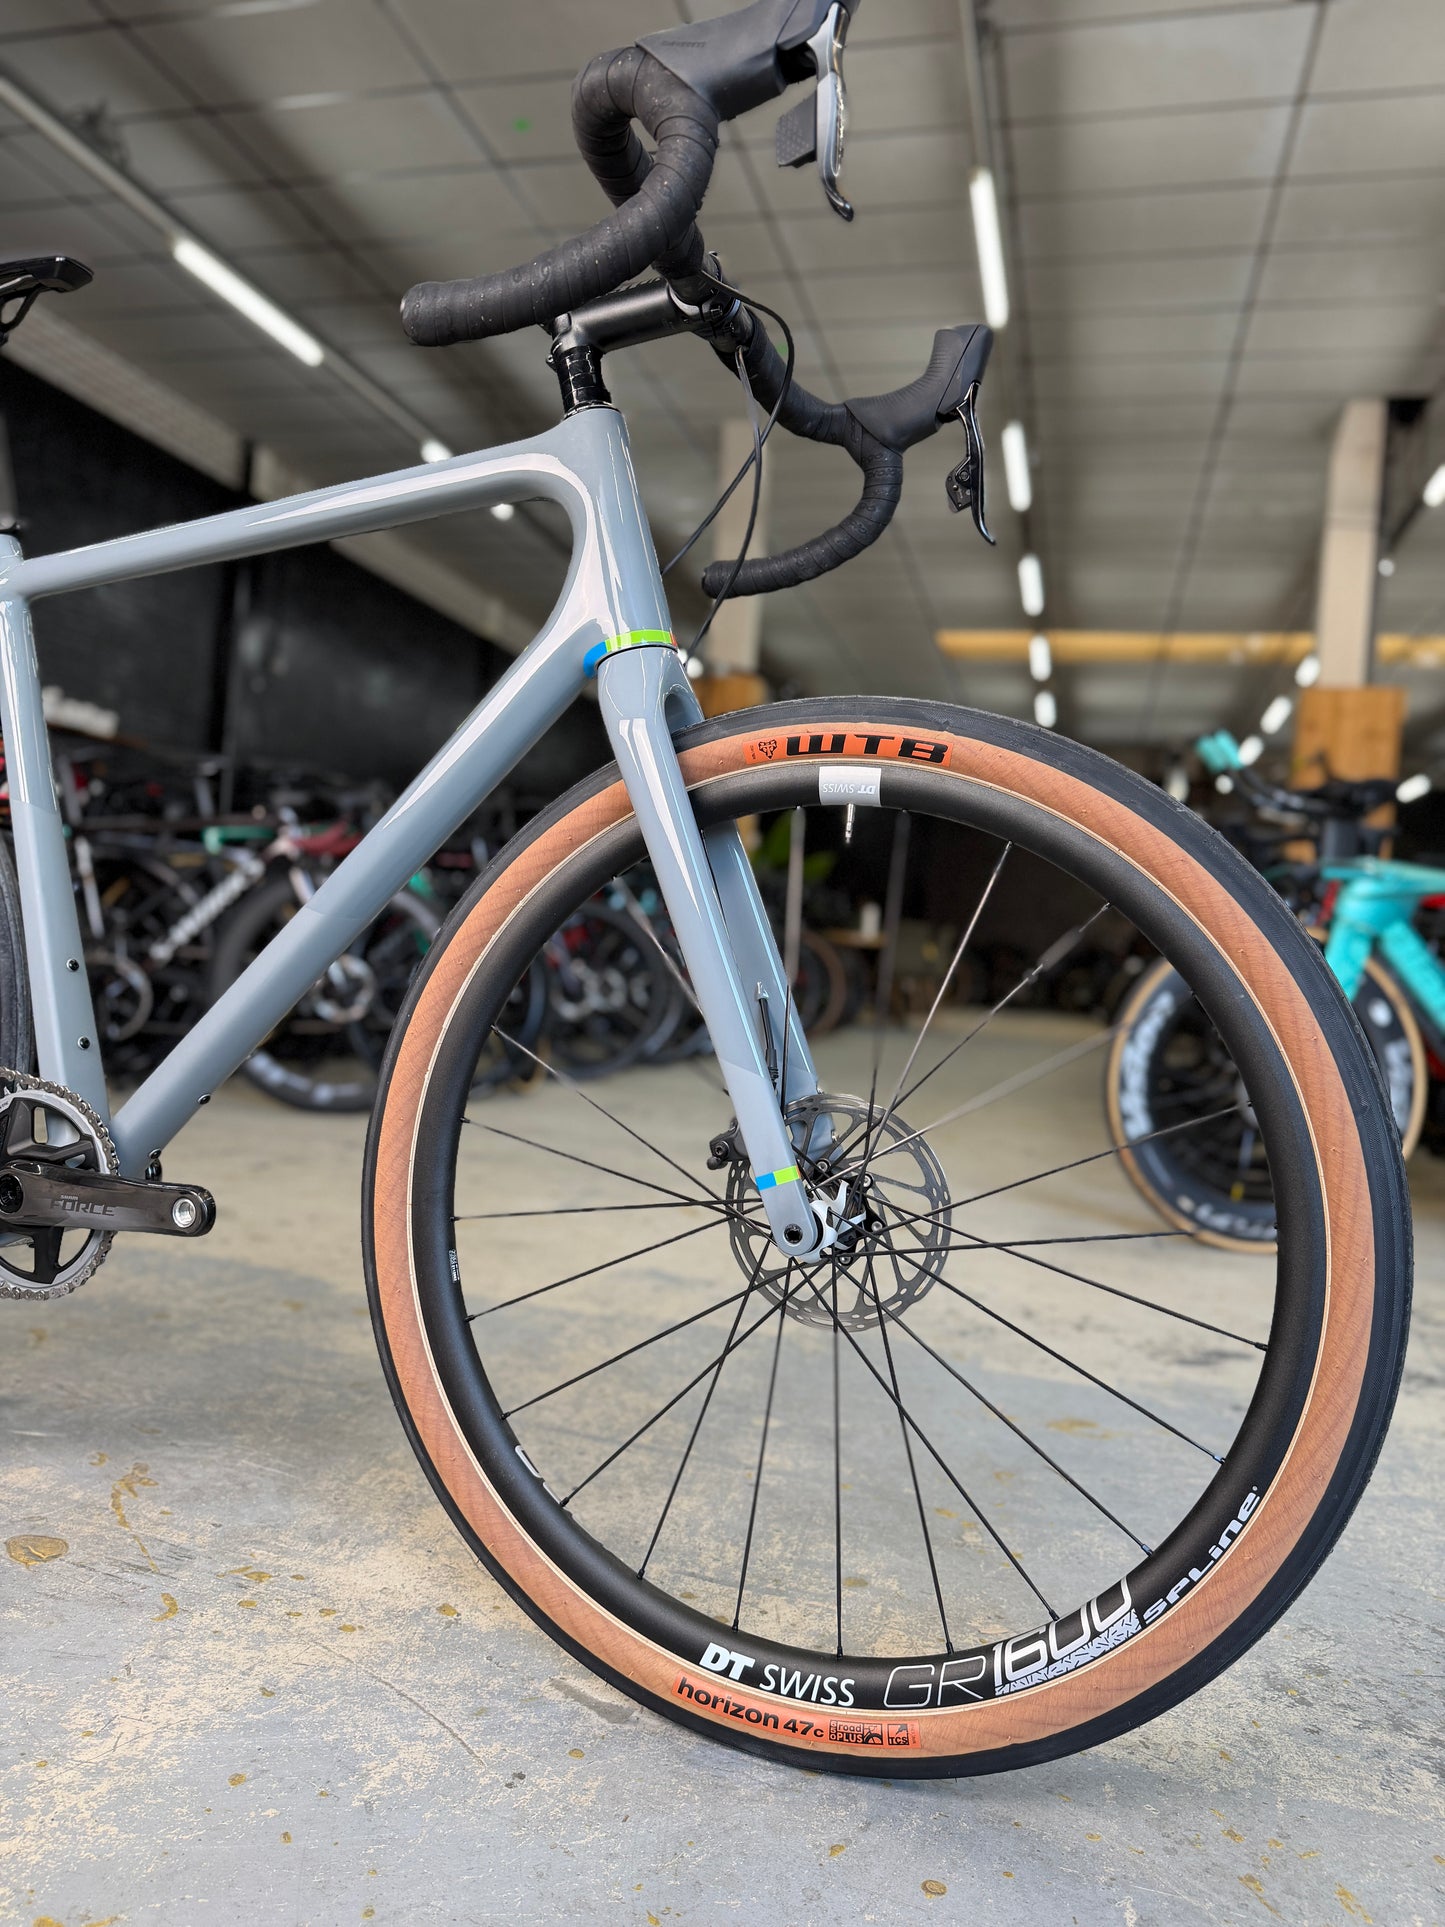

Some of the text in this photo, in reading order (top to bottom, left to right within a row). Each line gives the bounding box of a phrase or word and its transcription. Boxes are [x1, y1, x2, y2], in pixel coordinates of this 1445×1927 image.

[786, 733, 949, 764] WTB
[822, 783, 876, 795] DT SWISS
[50, 1200, 115, 1217] FORCE
[699, 1642, 856, 1707] DT SWISS
[677, 1677, 824, 1739] horizon 47c
[838, 1723, 862, 1733] road
[837, 1732, 863, 1744] PLUS
[889, 1736, 909, 1745] TCS
